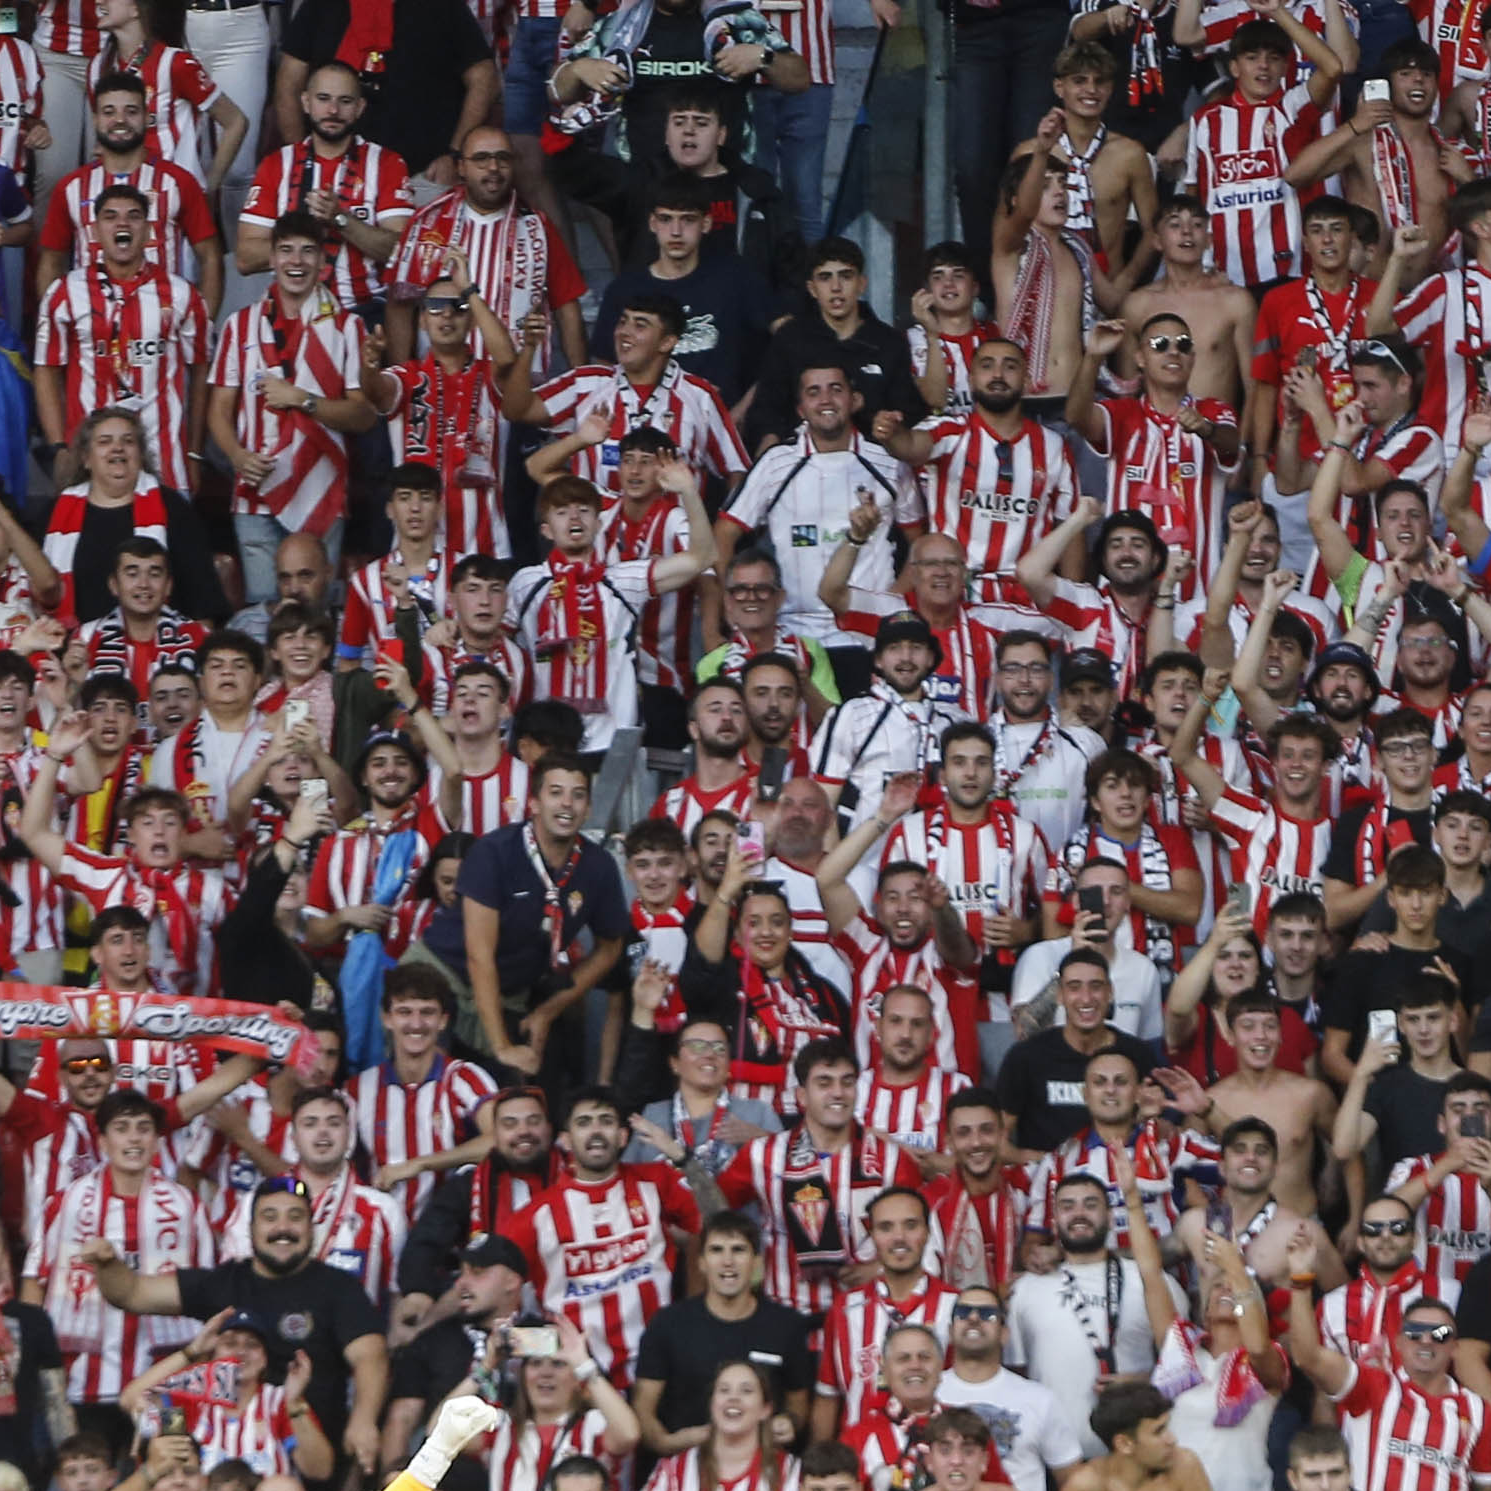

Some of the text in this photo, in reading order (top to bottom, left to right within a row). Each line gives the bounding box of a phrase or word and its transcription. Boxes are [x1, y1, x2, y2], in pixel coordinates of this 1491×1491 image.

[1213, 186, 1285, 209] Asturias
[961, 490, 1039, 515] JALISCO
[131, 991, 297, 1059] Sporting
[564, 1264, 651, 1297] Asturias
[1387, 1438, 1464, 1470] SIROKO
